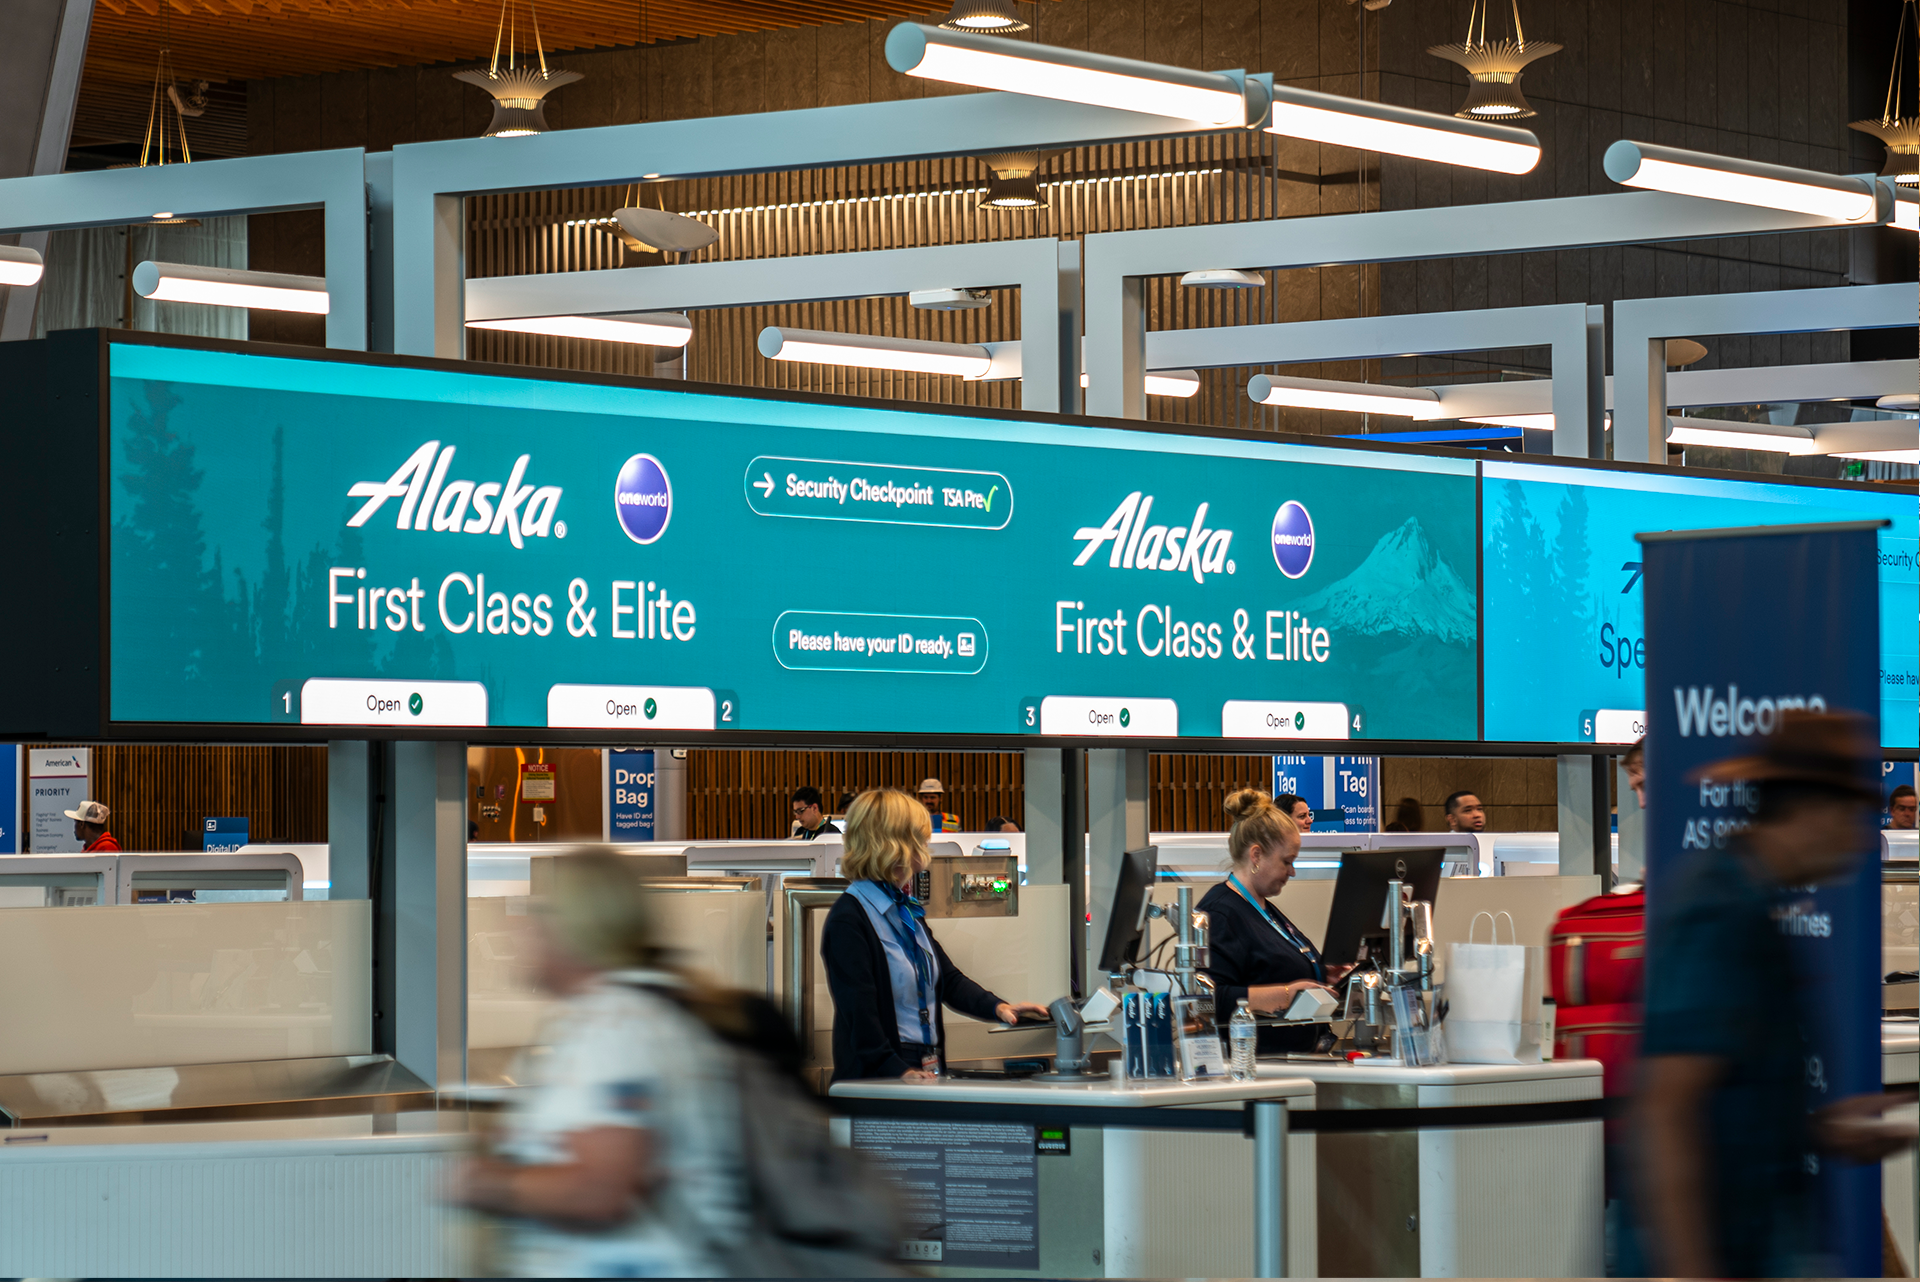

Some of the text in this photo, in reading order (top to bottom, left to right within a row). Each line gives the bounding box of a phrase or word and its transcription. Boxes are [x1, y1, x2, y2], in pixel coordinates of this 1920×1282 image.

[618, 492, 667, 507] oneworld
[786, 473, 847, 504] Security
[850, 478, 933, 508] Checkpoint
[942, 488, 964, 507] TSA
[1274, 532, 1311, 547] oneworld
[329, 566, 697, 642] First Class & Elite
[1056, 601, 1331, 663] First Class & Elite
[789, 629, 953, 659] Please have your ID ready.
[1879, 669, 1905, 686] Please
[282, 691, 291, 714] 1
[366, 694, 401, 714] Open
[606, 700, 638, 719] Open
[721, 700, 733, 722] 2
[1025, 707, 1035, 727] 3
[1088, 709, 1114, 726] Open
[1266, 713, 1290, 730] Open
[1352, 714, 1362, 732] 4
[1583, 718, 1592, 736] 5
[528, 764, 549, 772] NOTICE
[615, 769, 655, 788] Drop
[1277, 771, 1297, 795] Tag
[1340, 771, 1367, 797] Tag
[35, 788, 70, 797] PRIORITY
[615, 788, 648, 808] Bag
[616, 821, 638, 829] tagged
[639, 821, 651, 829] bag
[1356, 817, 1362, 825] to
